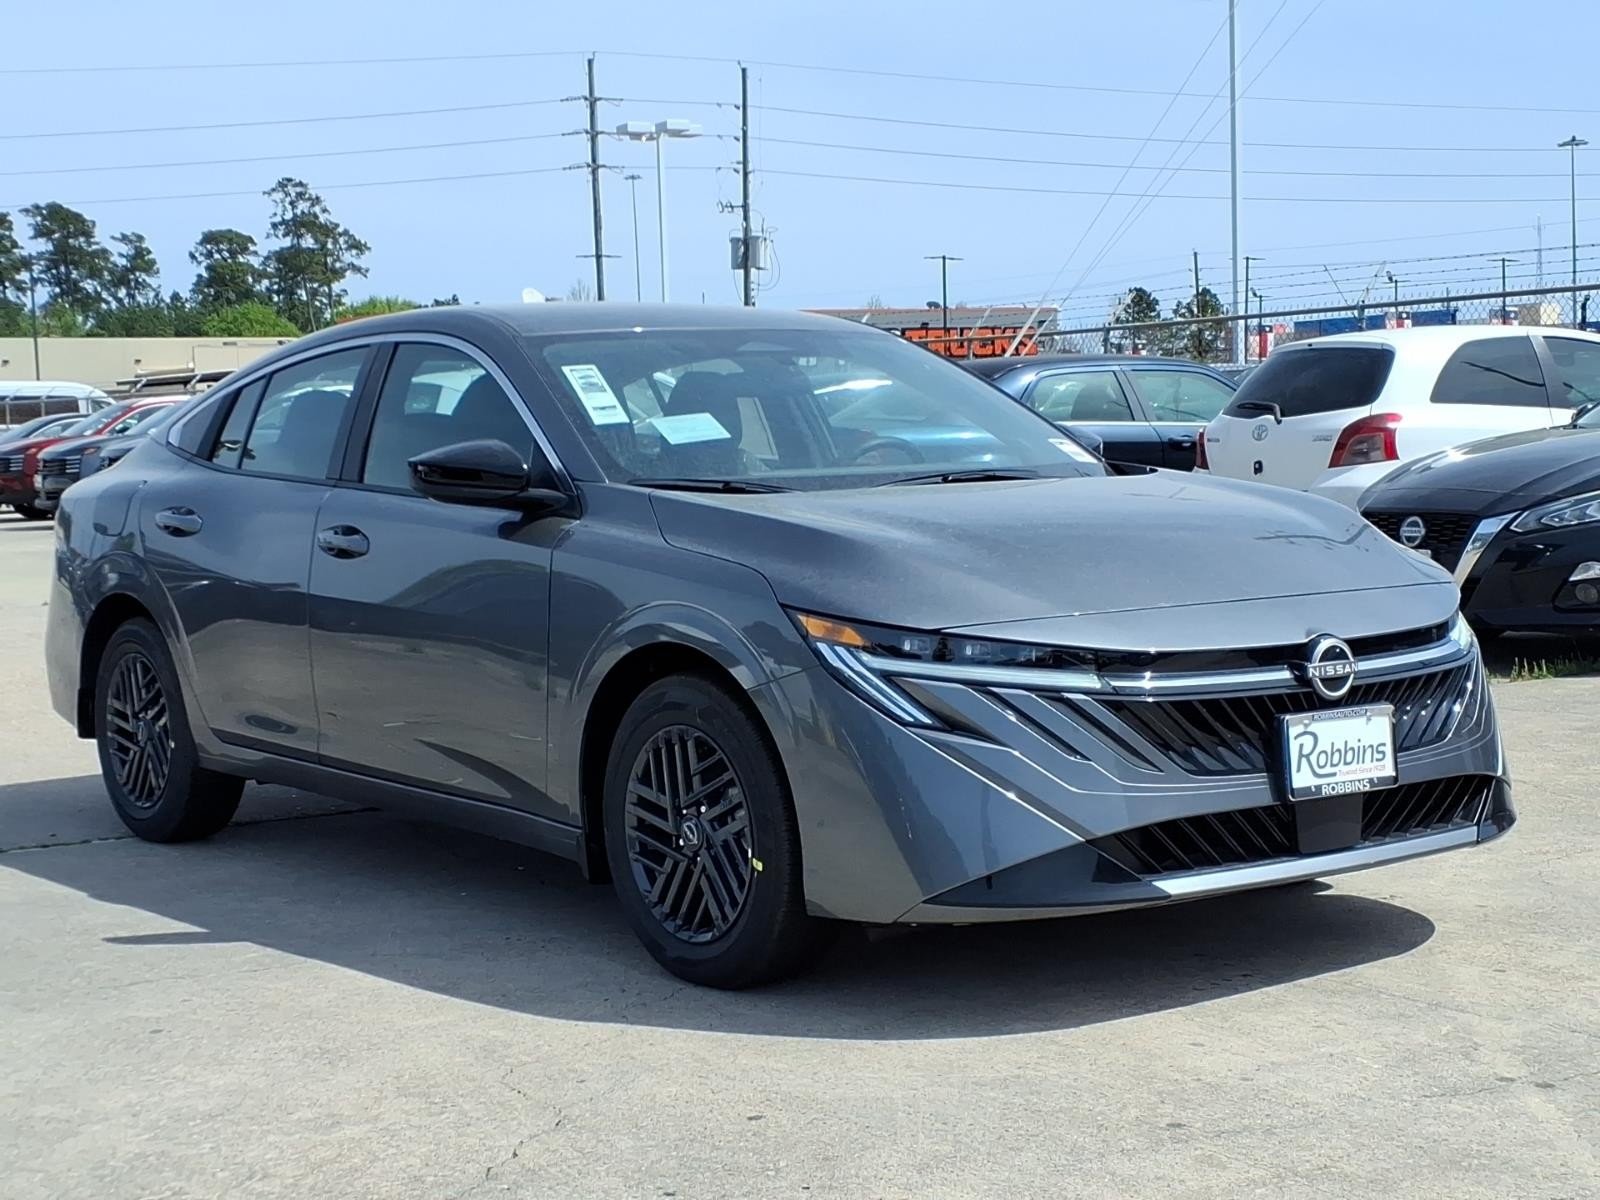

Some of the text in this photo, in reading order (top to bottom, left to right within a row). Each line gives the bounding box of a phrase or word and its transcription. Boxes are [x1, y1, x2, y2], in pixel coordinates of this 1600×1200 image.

[1309, 662, 1358, 677] NISSAN
[1294, 731, 1386, 778] Robbins
[1321, 780, 1370, 795] ROBBINS
